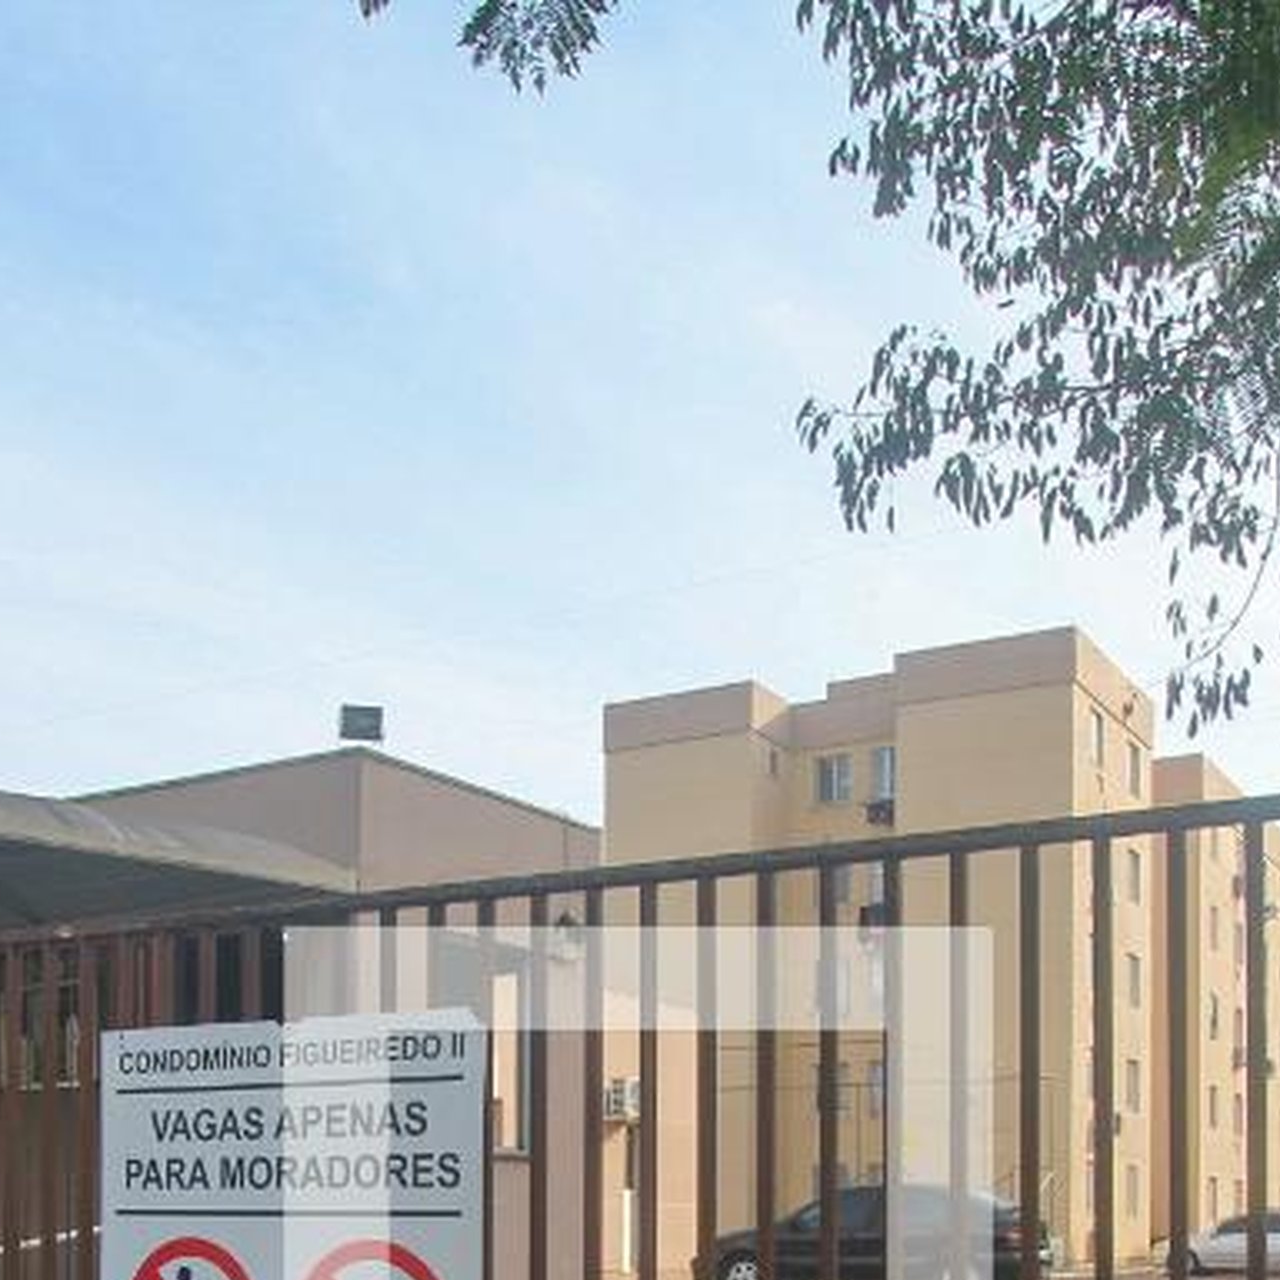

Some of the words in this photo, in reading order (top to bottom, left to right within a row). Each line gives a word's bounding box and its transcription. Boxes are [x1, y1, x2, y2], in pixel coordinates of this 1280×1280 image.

[279, 1035, 442, 1068] FIGUEIREDO
[452, 1032, 465, 1059] II
[151, 1106, 265, 1142] VAGAS
[273, 1101, 428, 1140] APENAS
[125, 1157, 211, 1191] PARA
[221, 1152, 461, 1190] MORADORES
